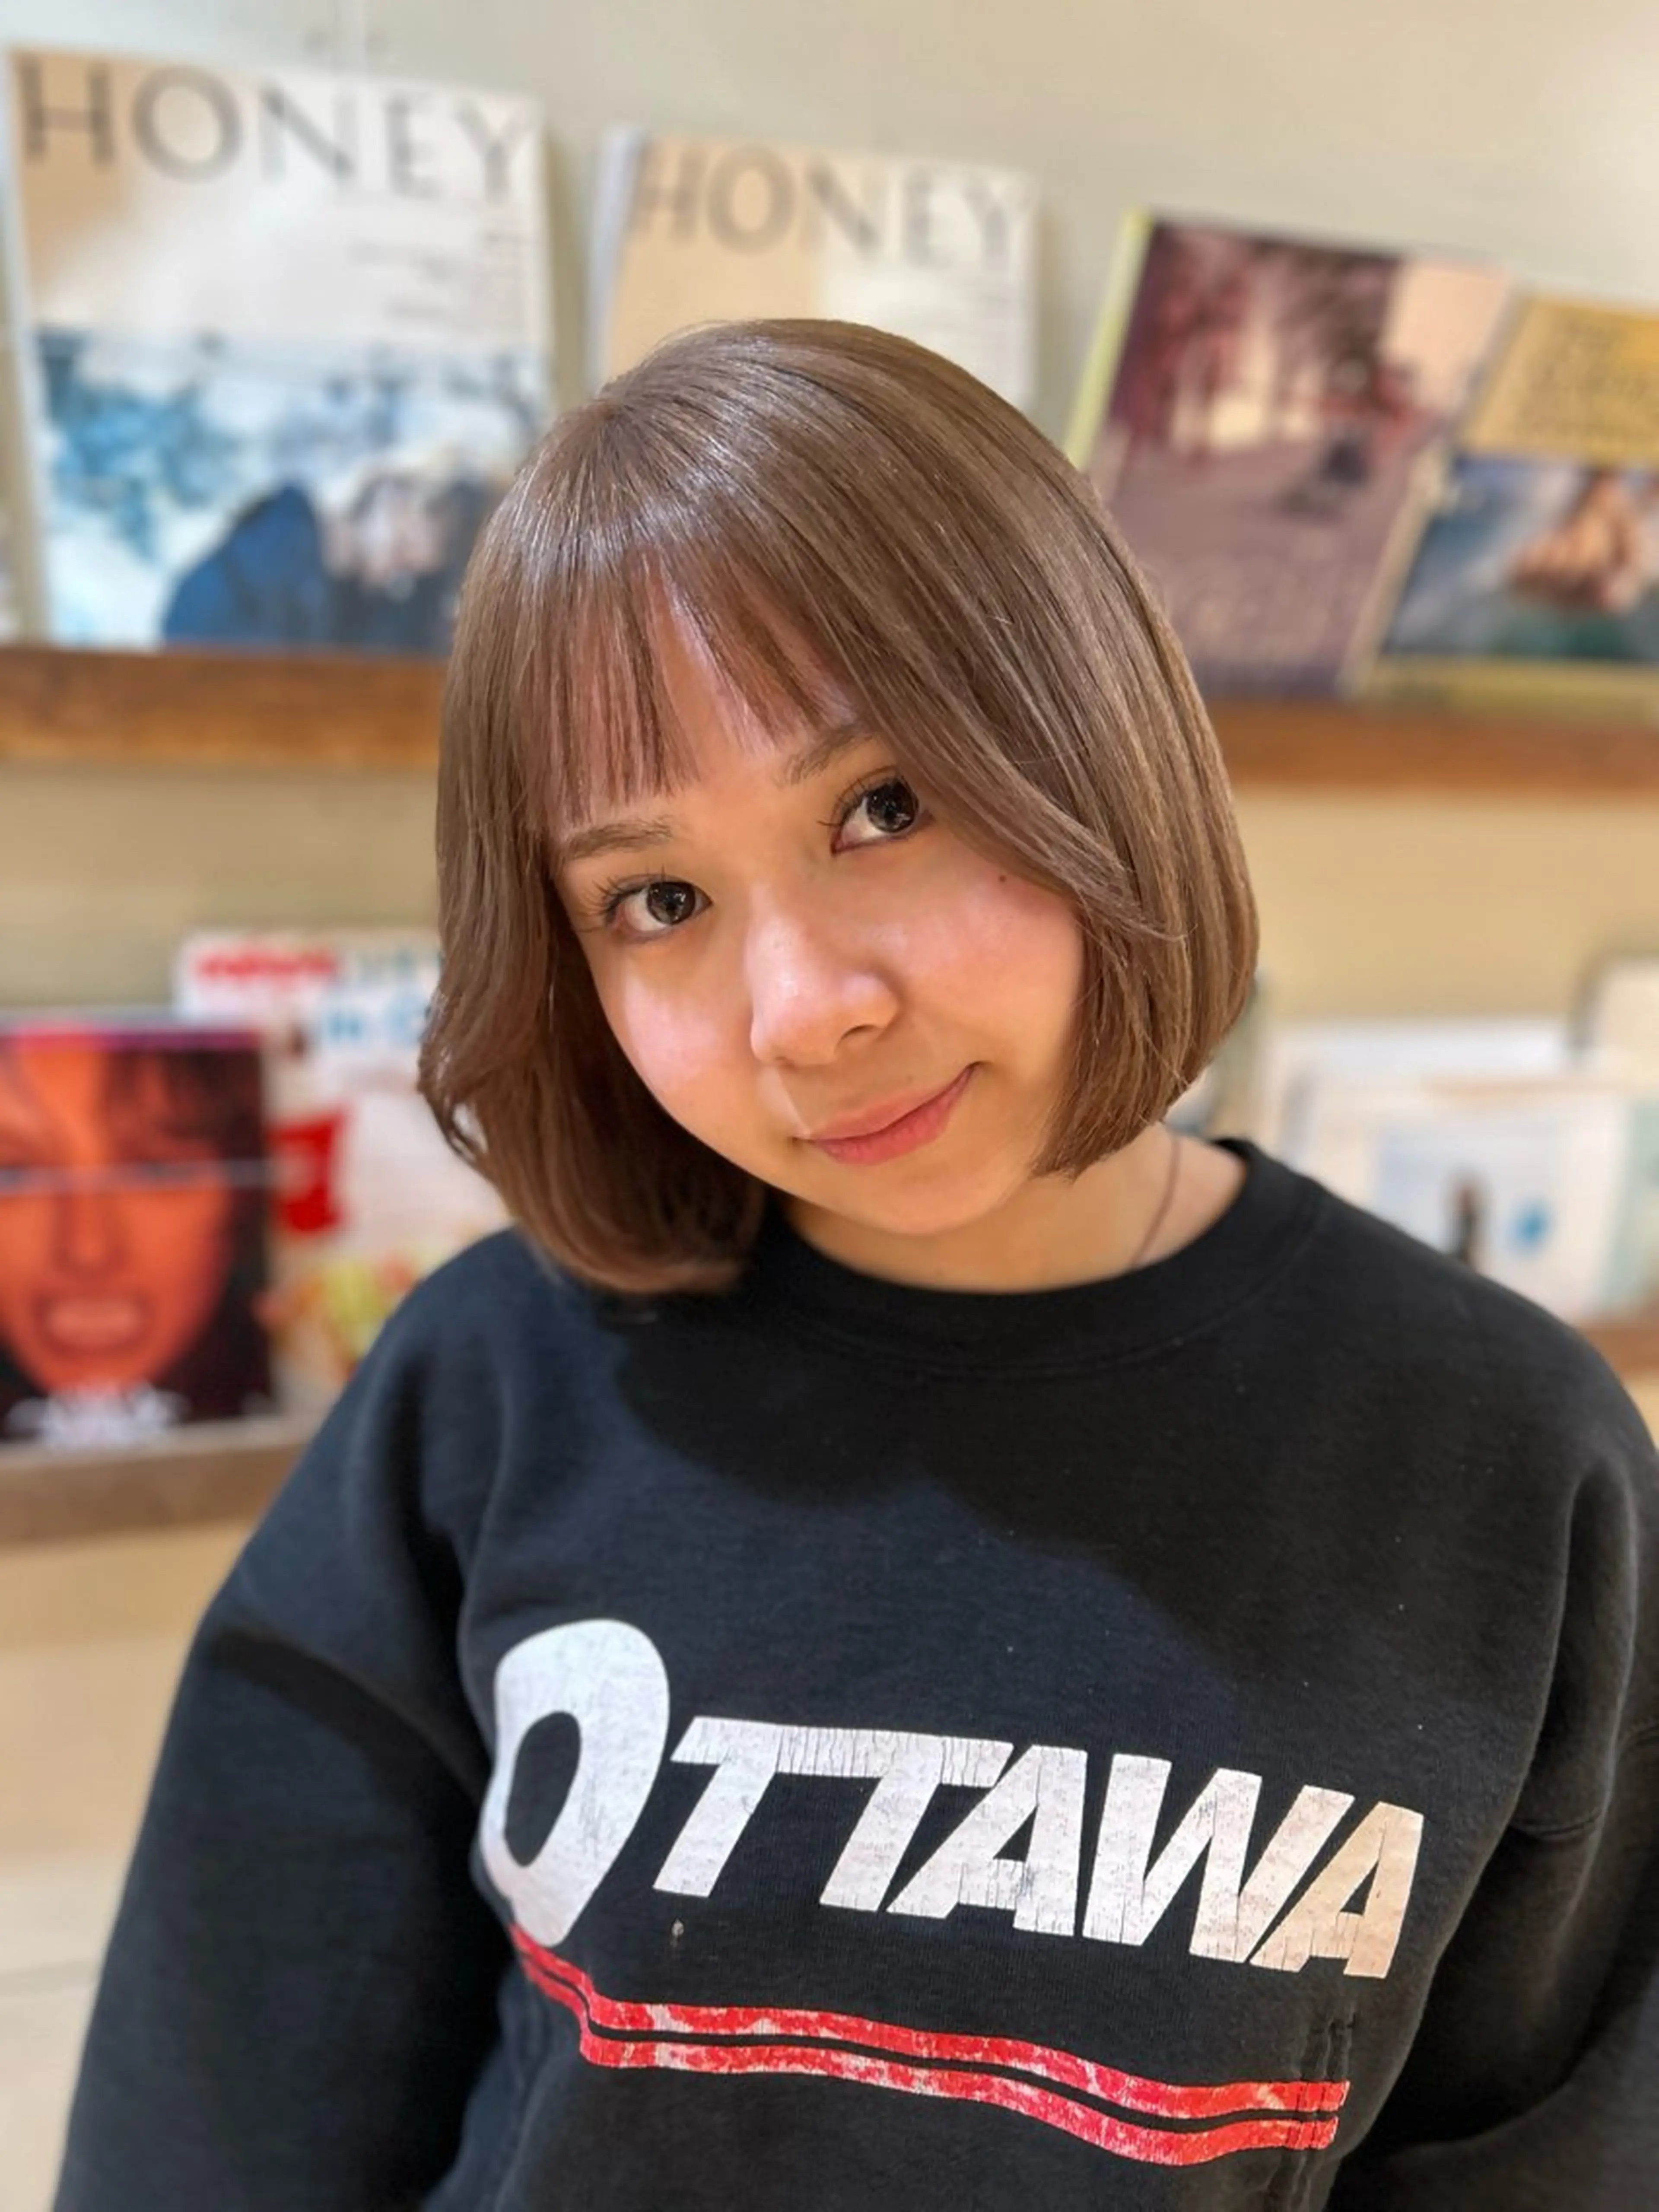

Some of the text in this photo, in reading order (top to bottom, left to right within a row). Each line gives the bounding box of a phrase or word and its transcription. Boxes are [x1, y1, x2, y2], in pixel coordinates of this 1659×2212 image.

[18, 53, 534, 205] HONEY
[635, 140, 1033, 269] HONEY
[480, 1619, 1424, 1979] OTTAWA
